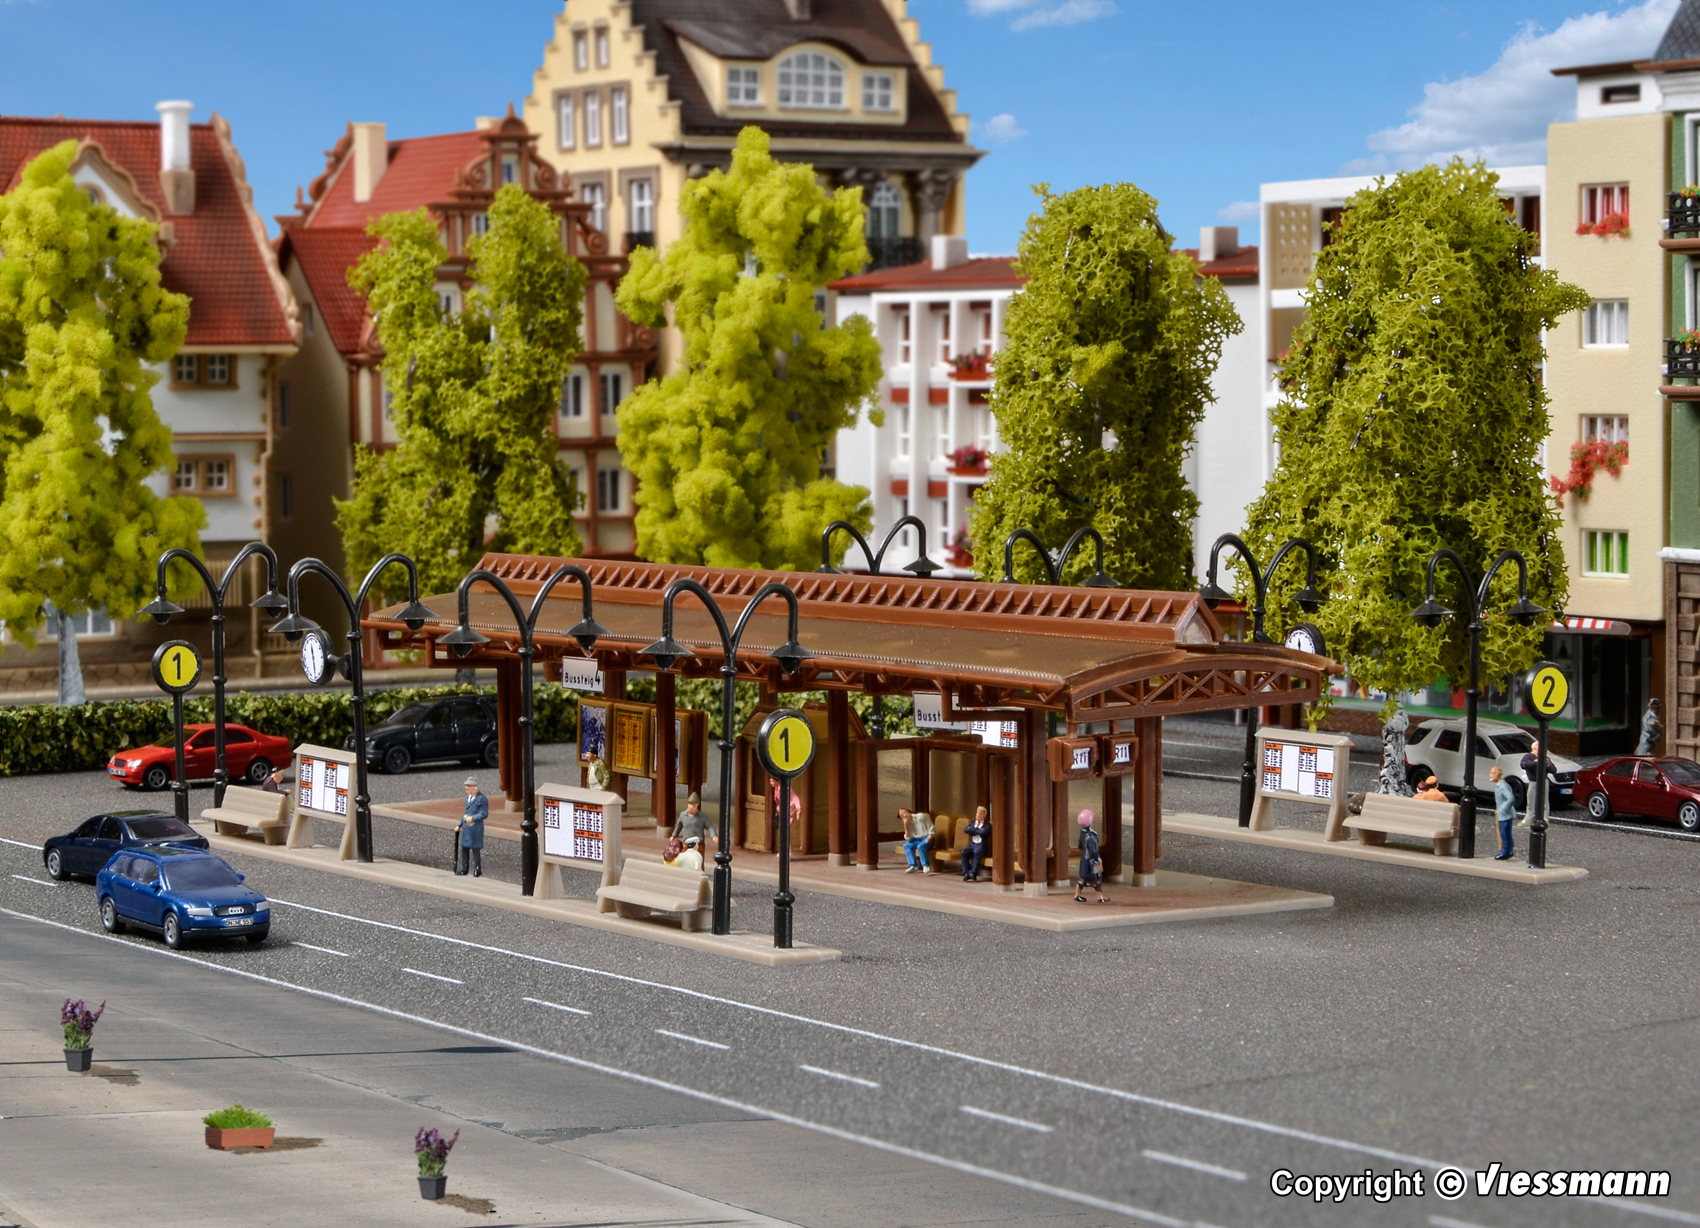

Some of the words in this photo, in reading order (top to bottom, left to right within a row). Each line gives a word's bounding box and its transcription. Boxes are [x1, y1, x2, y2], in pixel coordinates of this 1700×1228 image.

[172, 652, 181, 681] 1
[565, 672, 594, 688] Bussteig
[595, 670, 601, 685] 4
[1541, 675, 1556, 707] 2
[779, 727, 789, 763] 1
